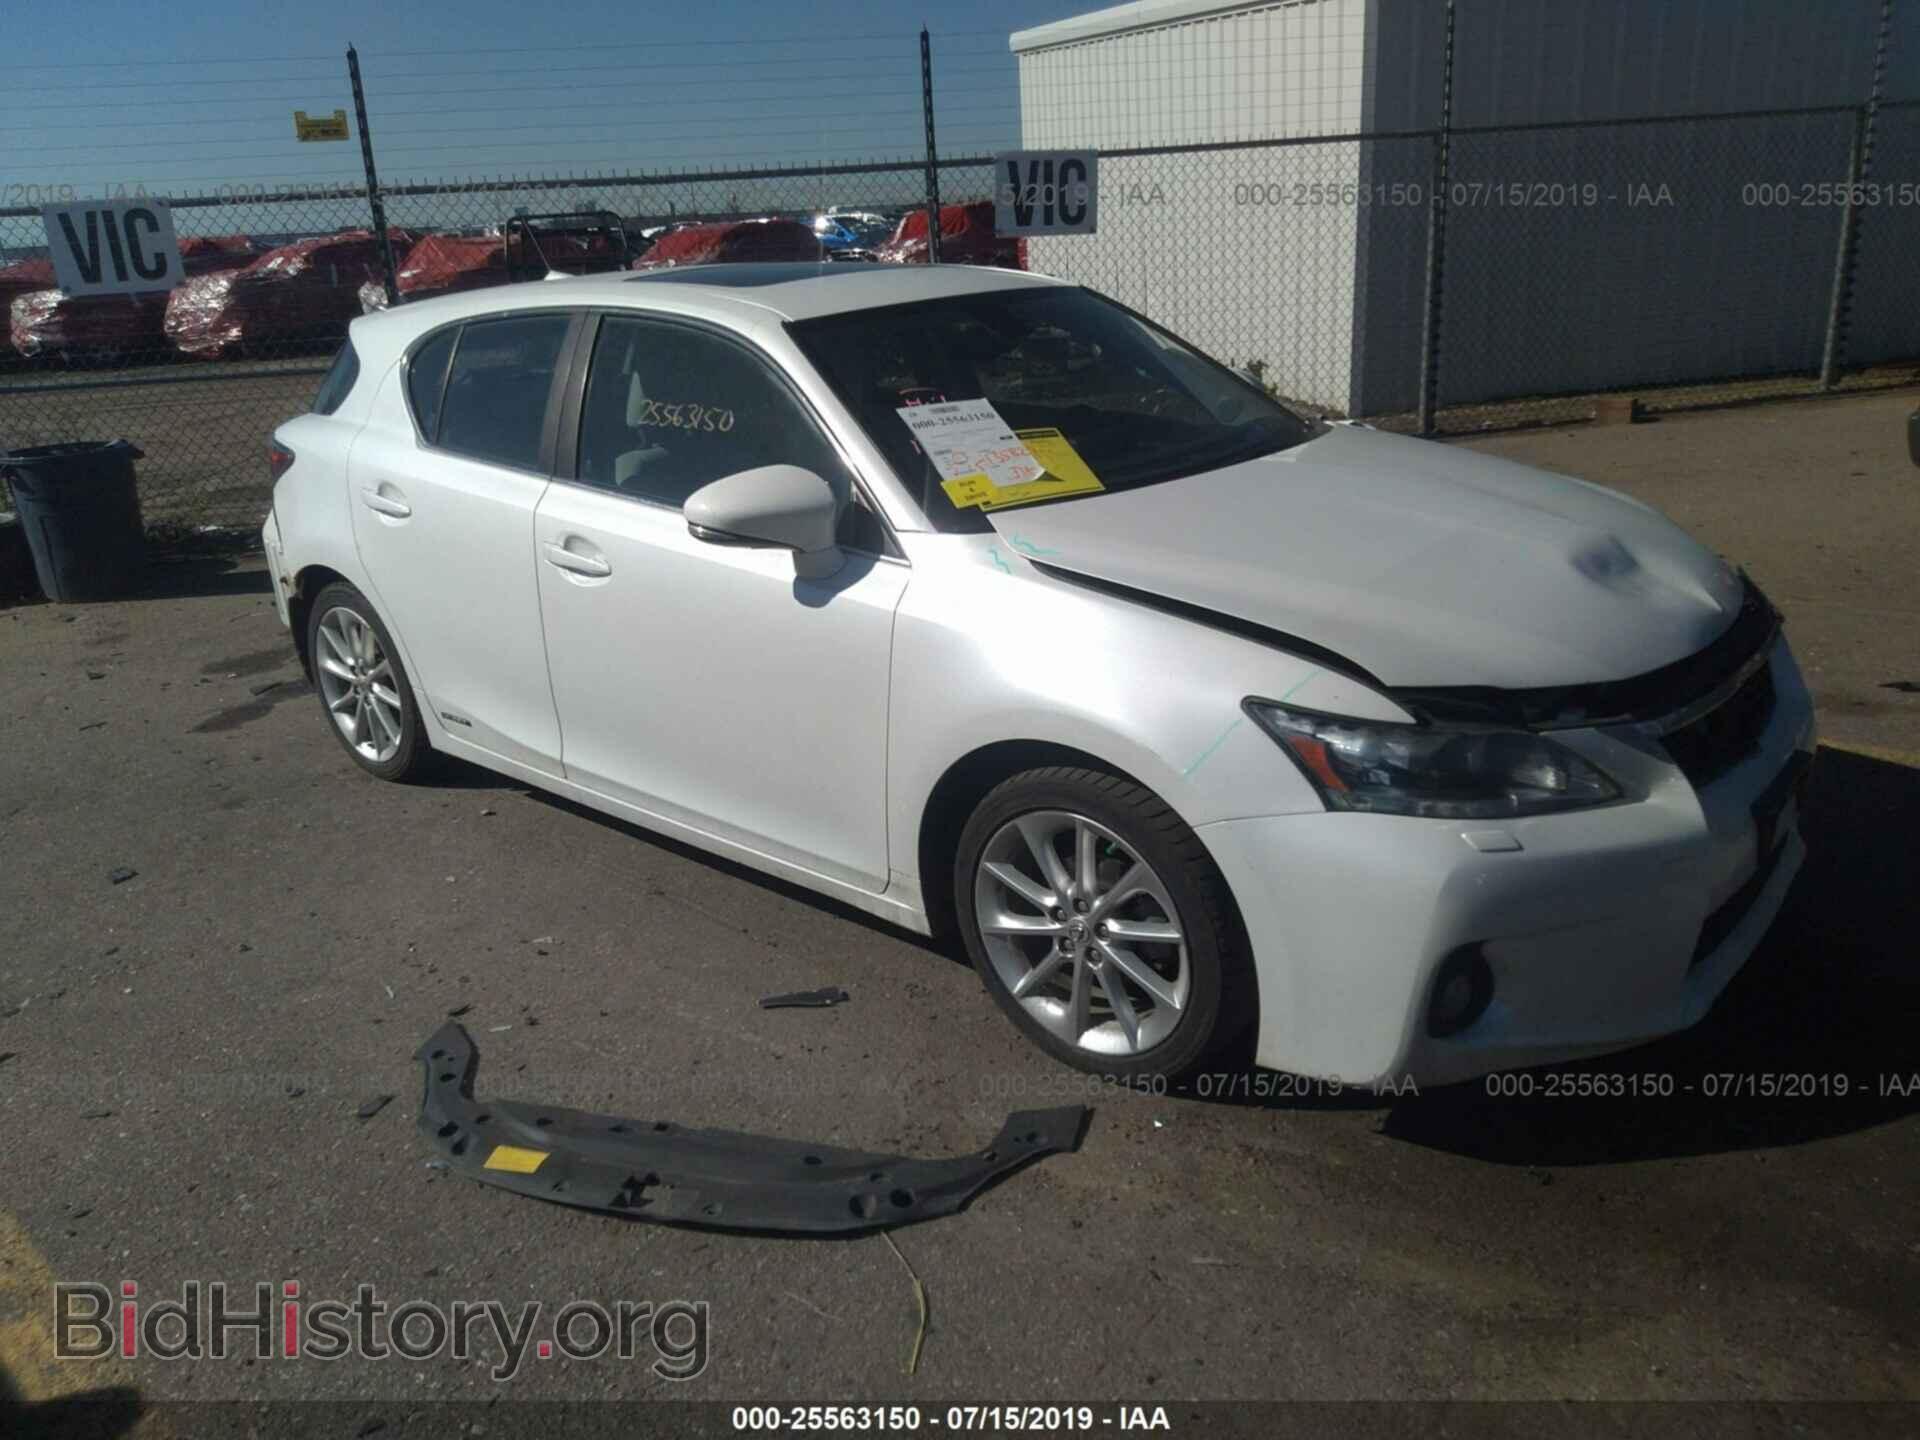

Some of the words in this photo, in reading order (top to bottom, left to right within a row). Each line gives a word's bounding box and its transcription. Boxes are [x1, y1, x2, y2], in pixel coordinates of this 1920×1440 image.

[1007, 158, 1087, 227] VIC
[57, 207, 168, 284] VIC
[638, 399, 735, 432] 25563150
